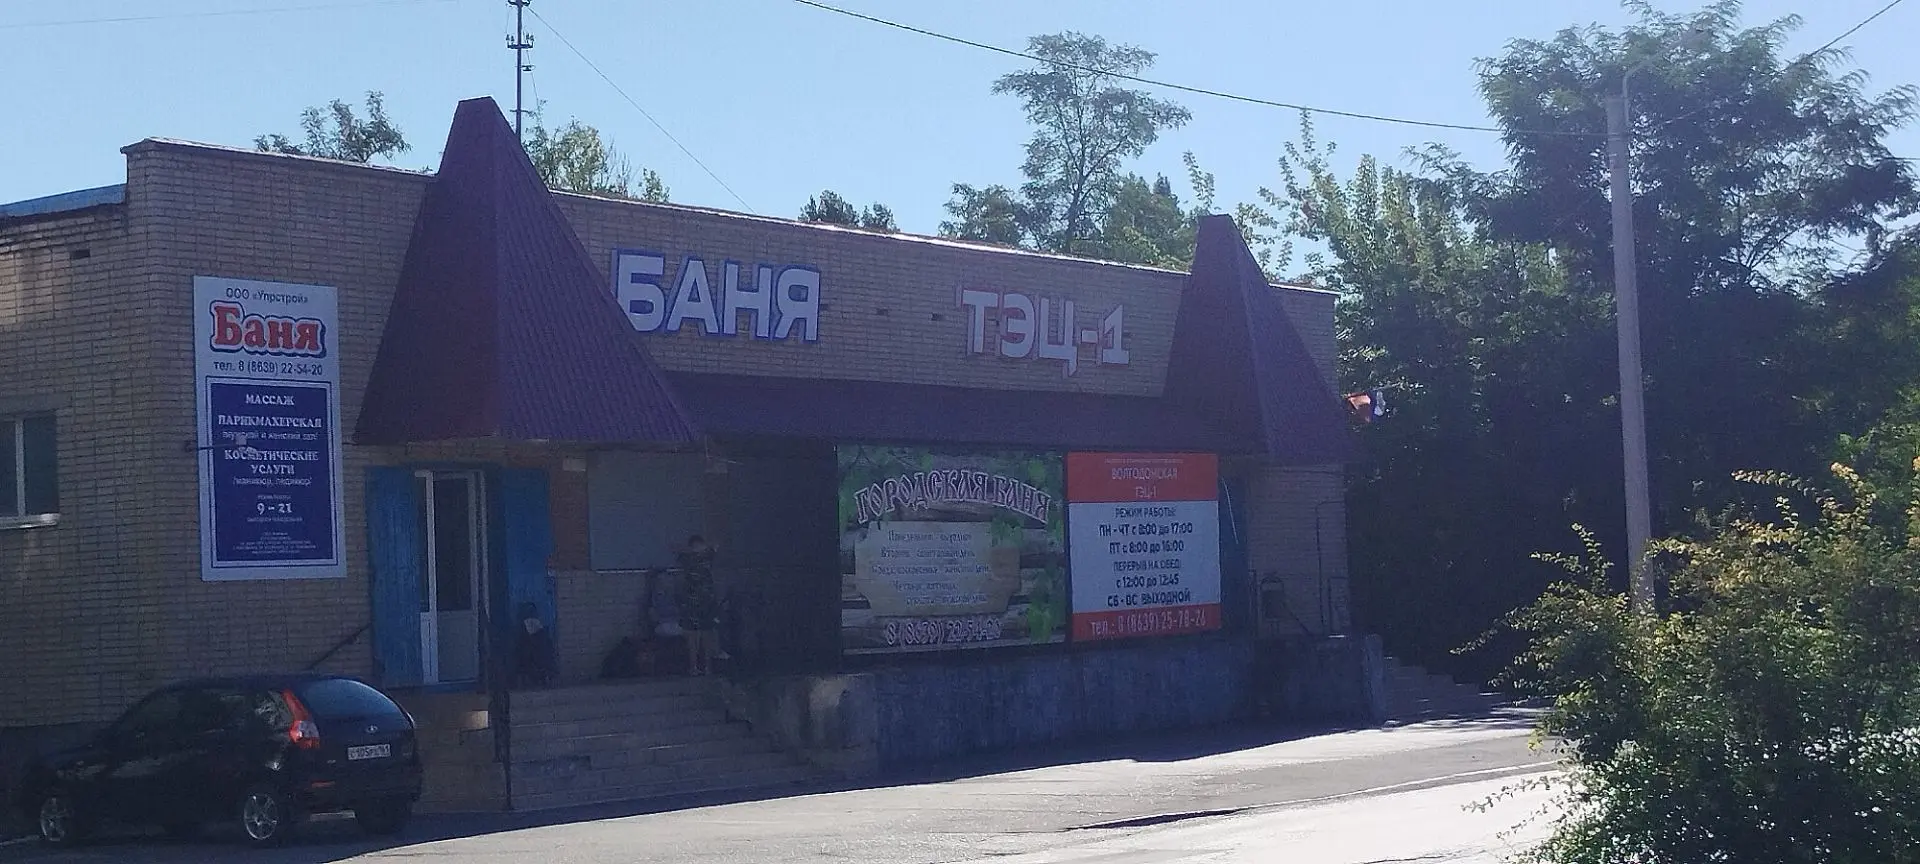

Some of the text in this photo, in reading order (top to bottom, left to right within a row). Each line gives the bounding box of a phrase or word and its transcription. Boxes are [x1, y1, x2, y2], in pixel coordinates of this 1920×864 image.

[225, 287, 250, 300] ООО
[612, 249, 821, 343] БАНЯ
[211, 300, 327, 358] Баня
[960, 288, 1130, 377] ТЭЦ-1
[213, 361, 236, 372] тел.
[281, 363, 323, 376] 22-54-20
[245, 393, 295, 406] МАССАЖ
[218, 414, 323, 428] ПАРИКМАХЕРСКАЯ
[250, 464, 295, 475] УСЛУГИ
[854, 470, 1051, 525] ГОРОДСКАЯ БАНЯ
[256, 502, 266, 515] 9
[277, 502, 293, 514] 21
[1099, 524, 1112, 537] ПН
[1118, 523, 1131, 535] ЧТ
[1170, 522, 1193, 534] 17:00
[1109, 542, 1120, 554] ПТ
[1129, 541, 1149, 553] 8:00
[1149, 543, 1161, 554] до
[1122, 575, 1146, 587] 12:00
[1146, 576, 1158, 588] до
[1159, 573, 1180, 586] 12:45
[1107, 594, 1119, 607] СБ
[1141, 587, 1192, 605] ВЫХОДНОЙ
